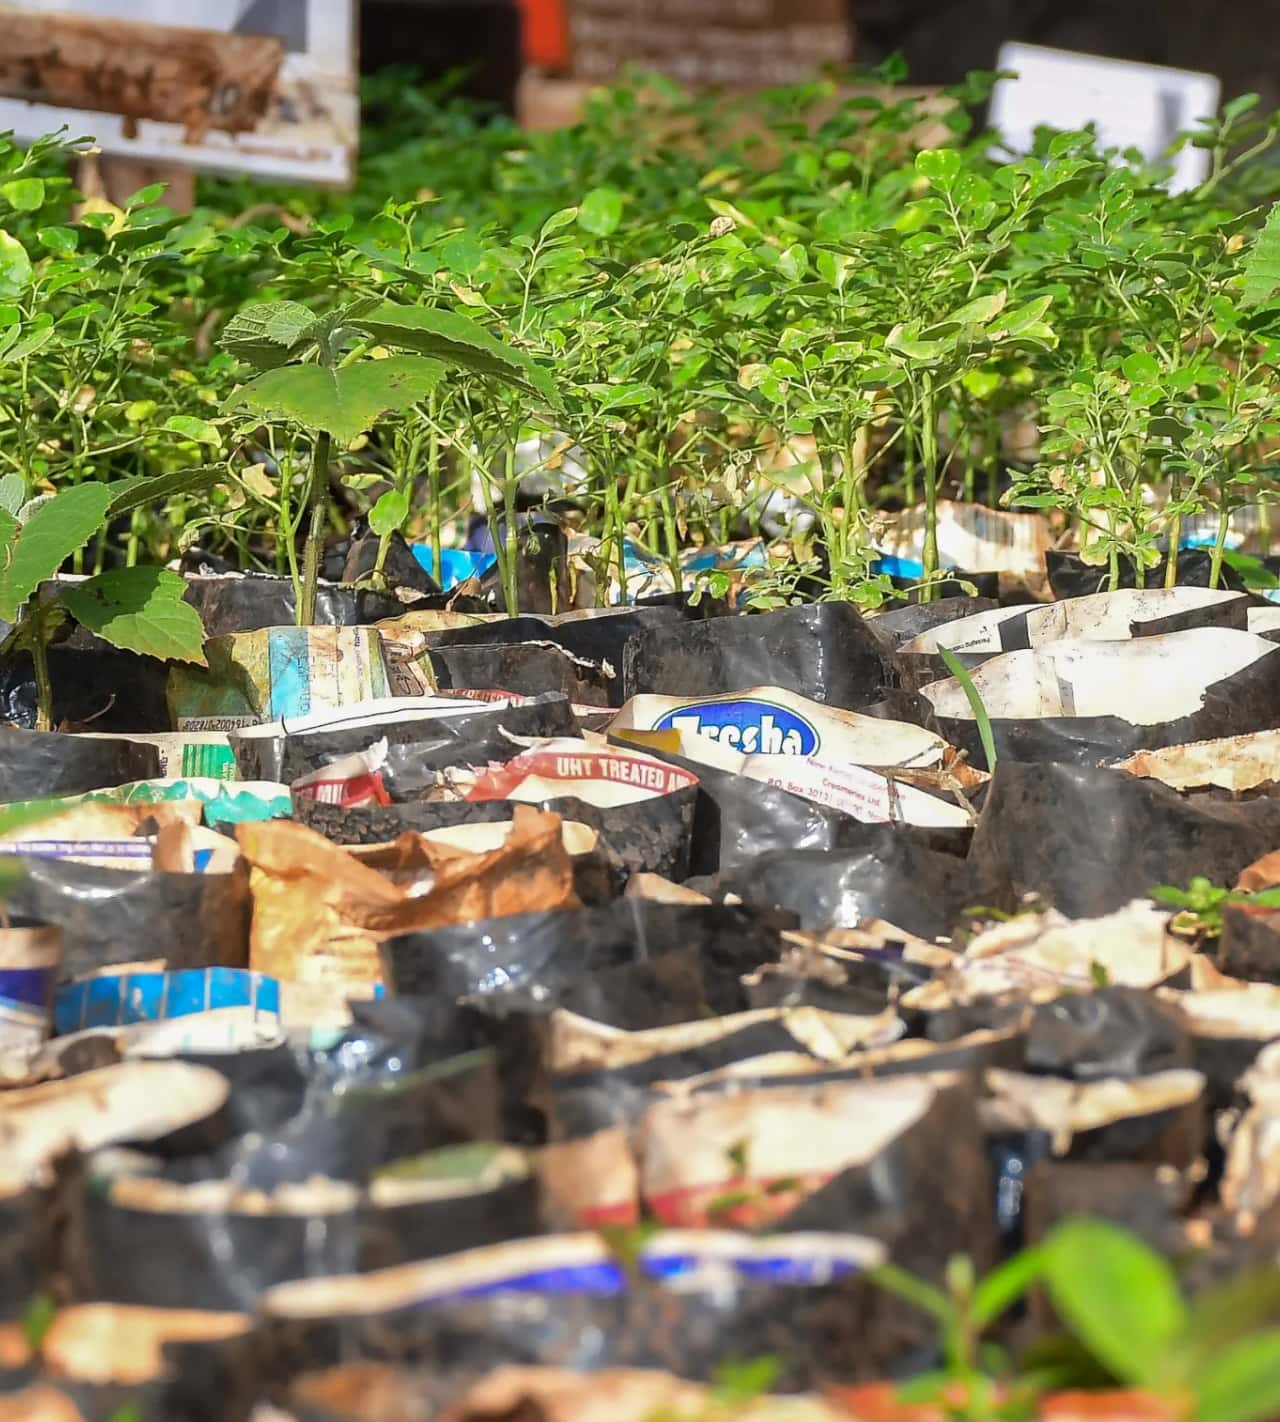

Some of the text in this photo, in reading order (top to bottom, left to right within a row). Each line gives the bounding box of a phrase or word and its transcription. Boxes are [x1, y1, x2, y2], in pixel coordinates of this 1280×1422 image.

[556, 757, 593, 776] UHT
[598, 758, 665, 789] TREATED
[787, 781, 804, 794] Box
